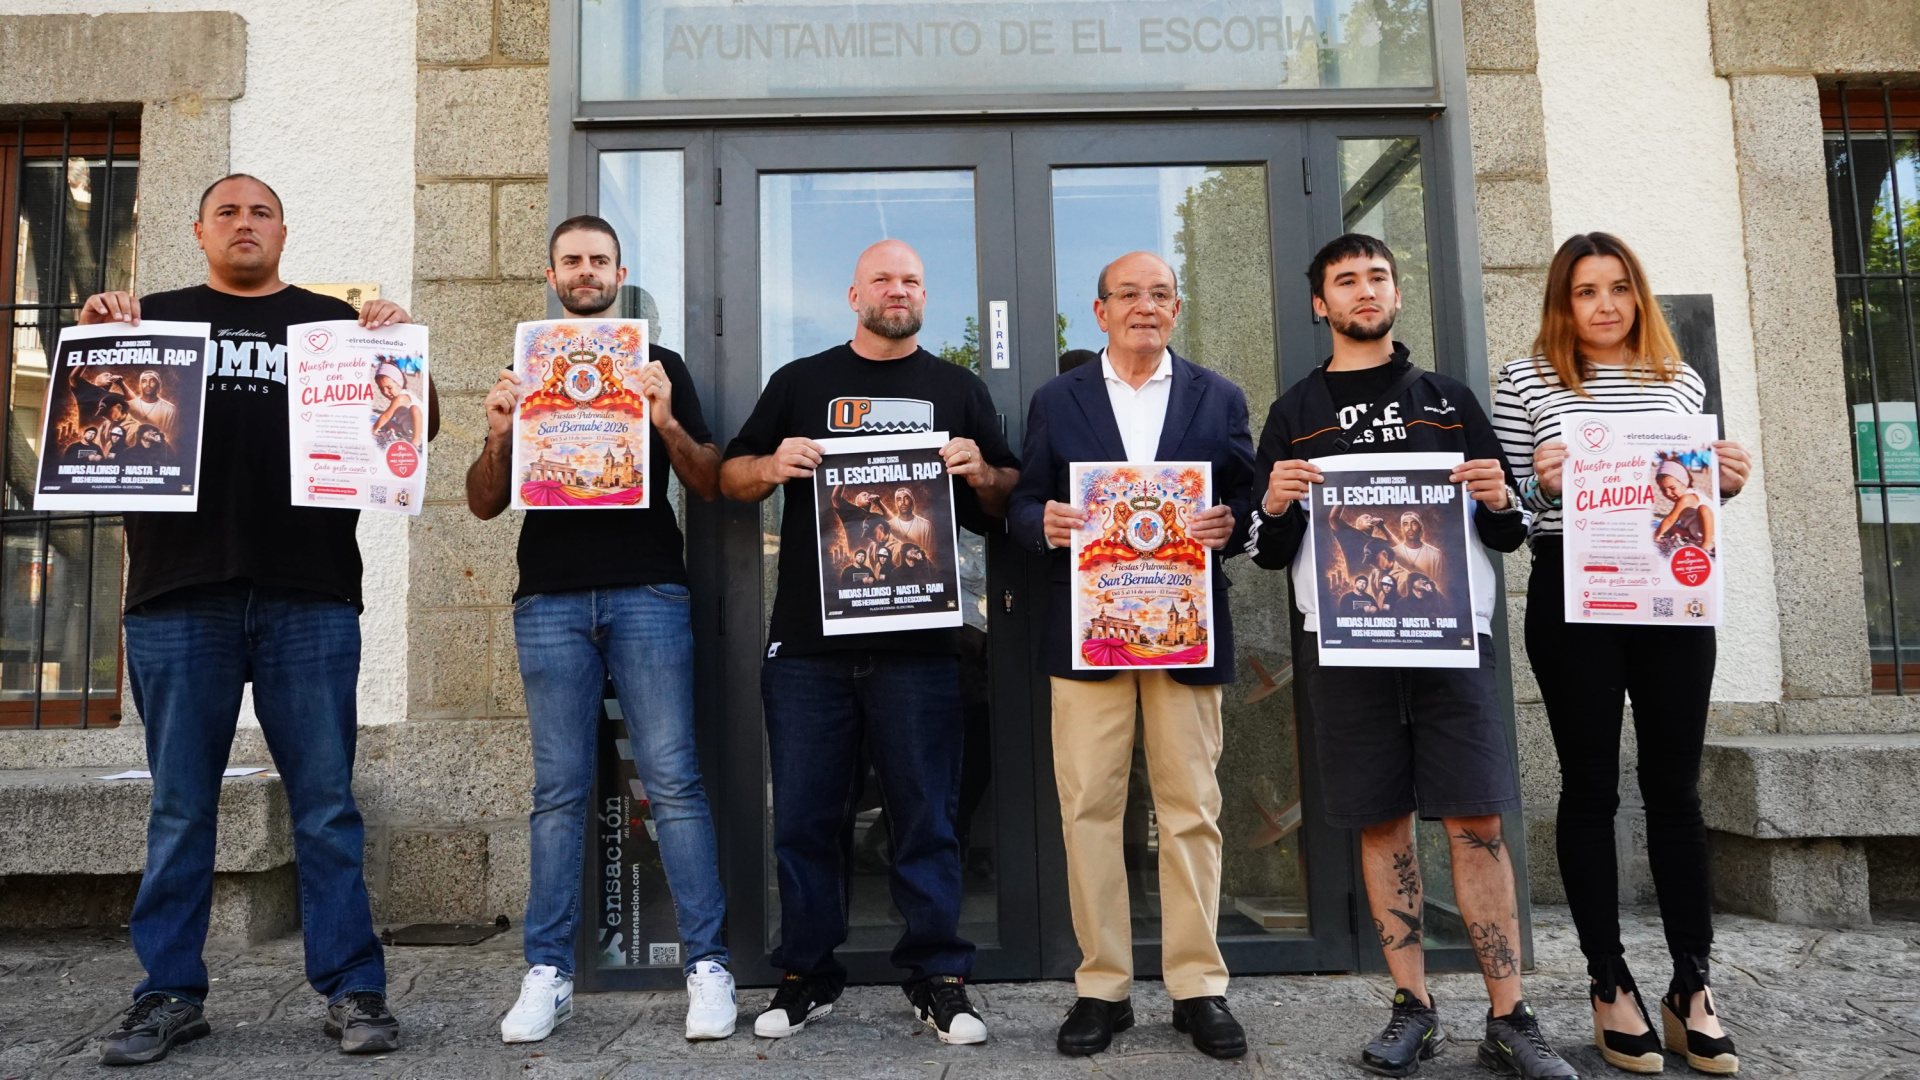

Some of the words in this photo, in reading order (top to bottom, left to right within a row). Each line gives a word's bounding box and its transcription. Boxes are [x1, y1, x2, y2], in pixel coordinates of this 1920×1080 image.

[664, 20, 982, 60] AYUNTAMIENTO
[999, 19, 1055, 56] DE
[1071, 18, 1123, 54] EL
[1139, 14, 1349, 54] ESCORIAL
[217, 328, 267, 338] Worldwide
[995, 309, 1004, 360] TIRAR
[66, 350, 85, 367] EL
[87, 348, 162, 365] ESCORIAL
[163, 349, 197, 366] RAP
[299, 360, 334, 373] Nuestro
[338, 358, 366, 371] pueblo
[208, 383, 269, 394] JEANS
[302, 383, 374, 405] CLAUDIA
[550, 411, 576, 420] Fiestas
[577, 410, 615, 419] Patronales
[537, 421, 558, 435] San
[559, 420, 602, 433] Bernabé
[603, 421, 629, 433] 2026
[58, 465, 85, 475] MIDAS
[86, 465, 120, 475] ALONSO
[125, 466, 153, 476] NASTA
[159, 466, 181, 476] RAIN
[314, 462, 330, 471] Cada
[332, 464, 347, 473] gesto
[1574, 459, 1612, 474] Nuestro
[1615, 456, 1647, 472] pueblo
[825, 468, 843, 486] EL
[844, 464, 911, 484] ESCORIAL
[912, 461, 942, 480] RAP
[1391, 476, 1407, 484] 2026
[1602, 475, 1622, 484] con
[1322, 487, 1342, 506] EL
[1343, 485, 1420, 506] ESCORIAL
[1421, 485, 1455, 504] RAP
[1576, 484, 1655, 512] CLAUDIA
[1111, 562, 1139, 572] Fiestas
[1139, 561, 1178, 571] Patronales
[1097, 573, 1120, 588] San
[1121, 571, 1167, 586] Bernabé
[1167, 573, 1192, 586] 2026
[1589, 575, 1606, 584] Cada
[1609, 577, 1625, 586] gesto
[838, 588, 862, 599] MIDAS
[862, 586, 891, 597] ALONSO
[896, 584, 920, 595] NASTA
[925, 583, 944, 593] RAIN
[1336, 617, 1363, 627] MIDAS
[1363, 617, 1397, 627] ALONSO
[1402, 617, 1430, 628] NASTA
[1436, 618, 1457, 628] RAIN
[598, 796, 627, 966] Sensación
